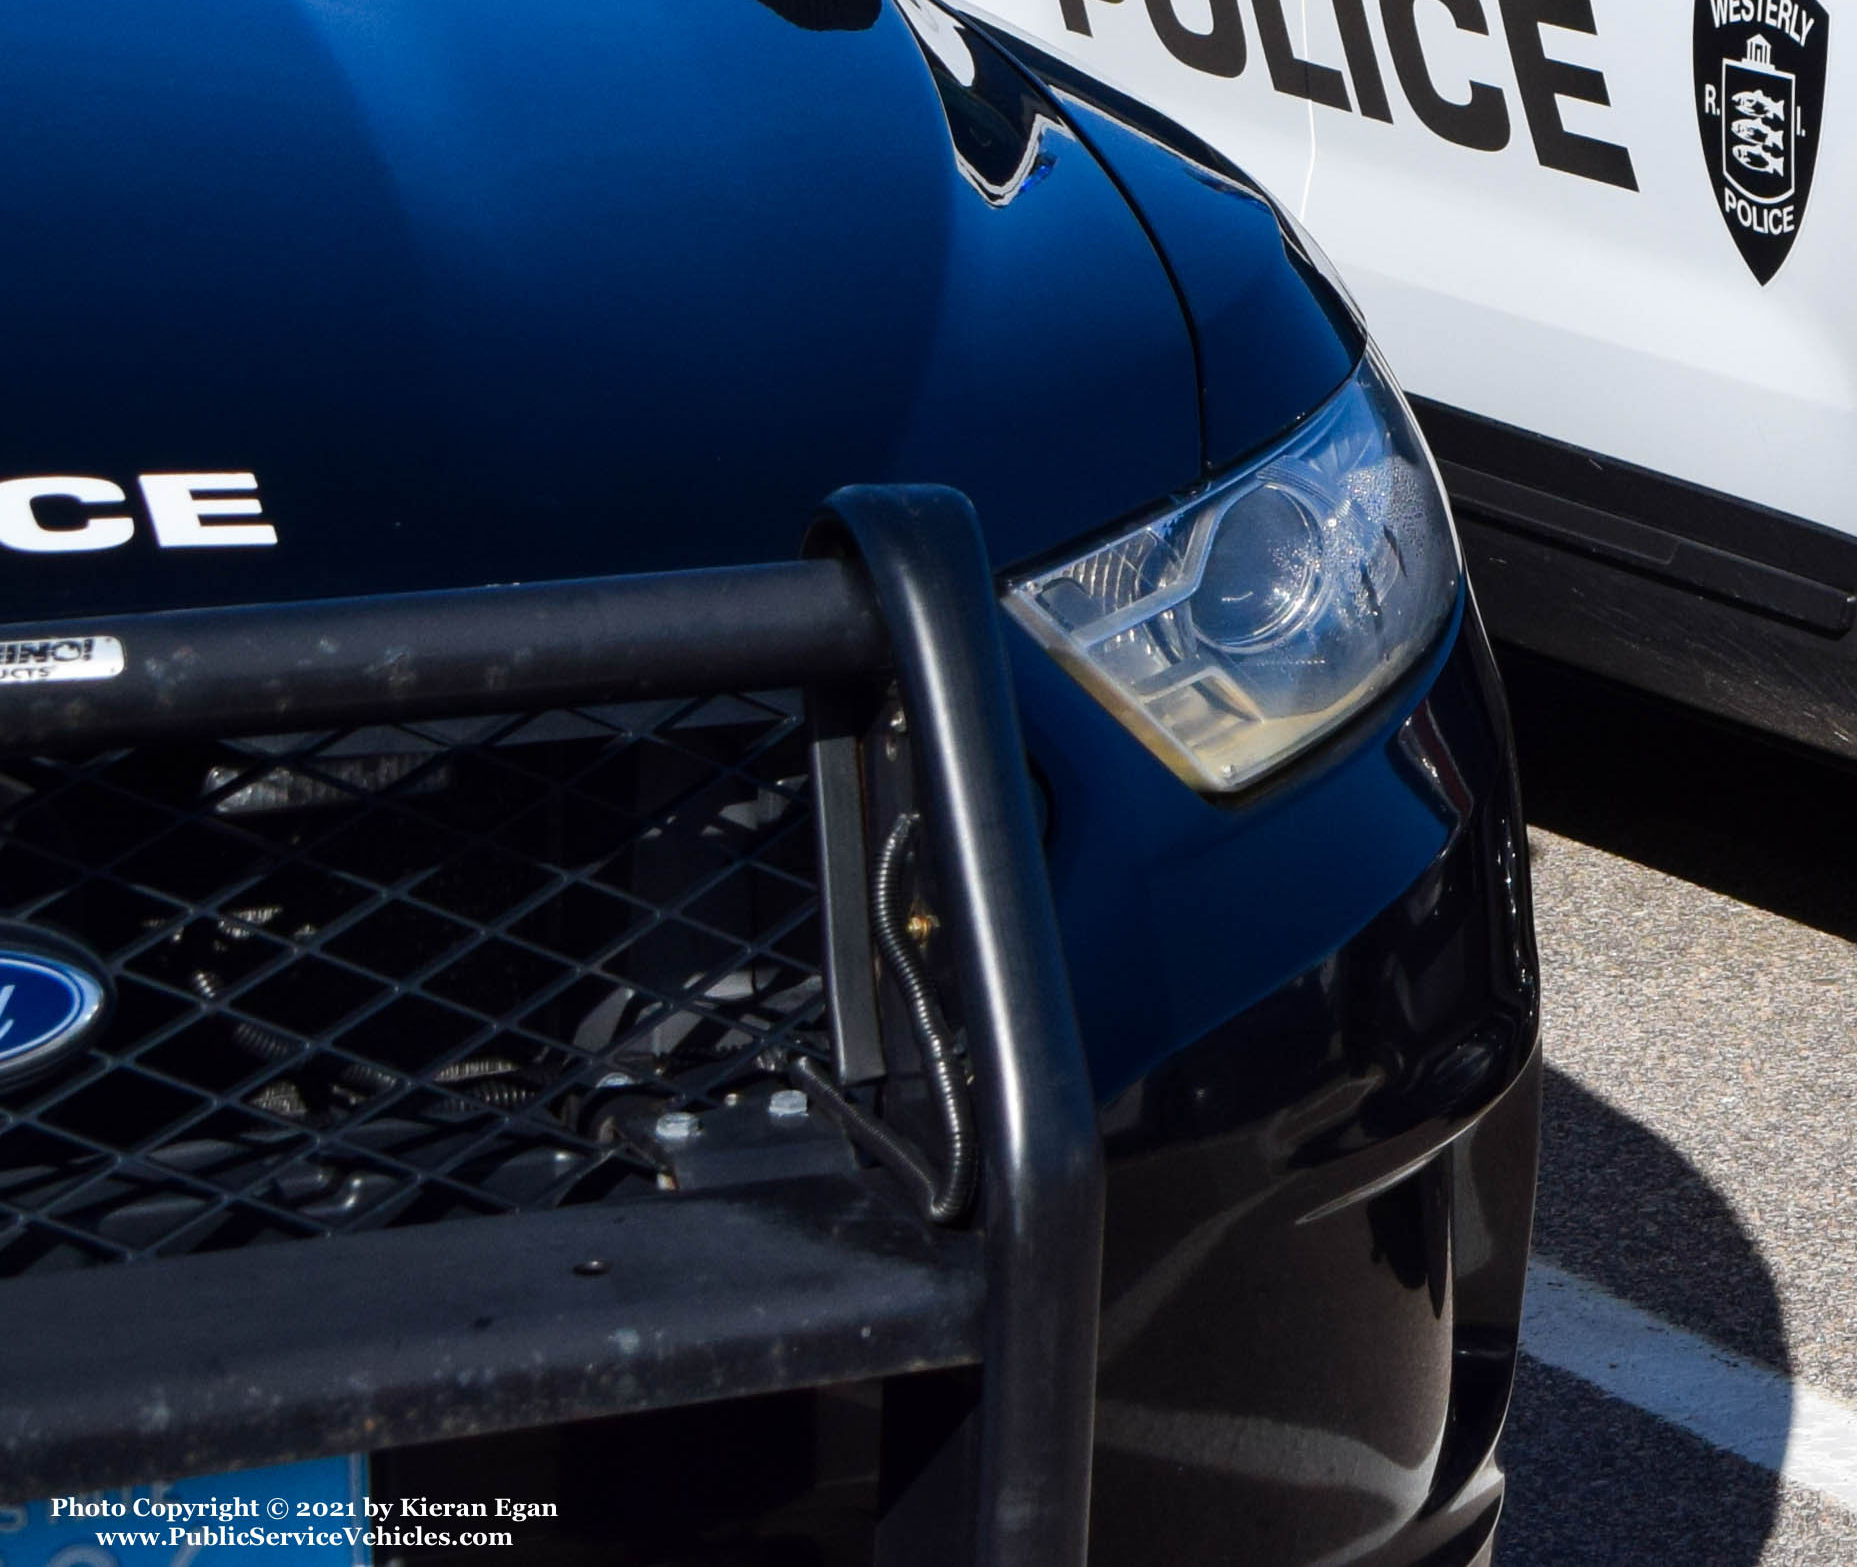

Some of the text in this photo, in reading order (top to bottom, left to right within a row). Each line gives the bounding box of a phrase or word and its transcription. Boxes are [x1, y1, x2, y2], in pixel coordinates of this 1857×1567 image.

[1704, 84, 1721, 116] R.
[1724, 186, 1795, 235] POLICE
[0, 472, 279, 554] CE
